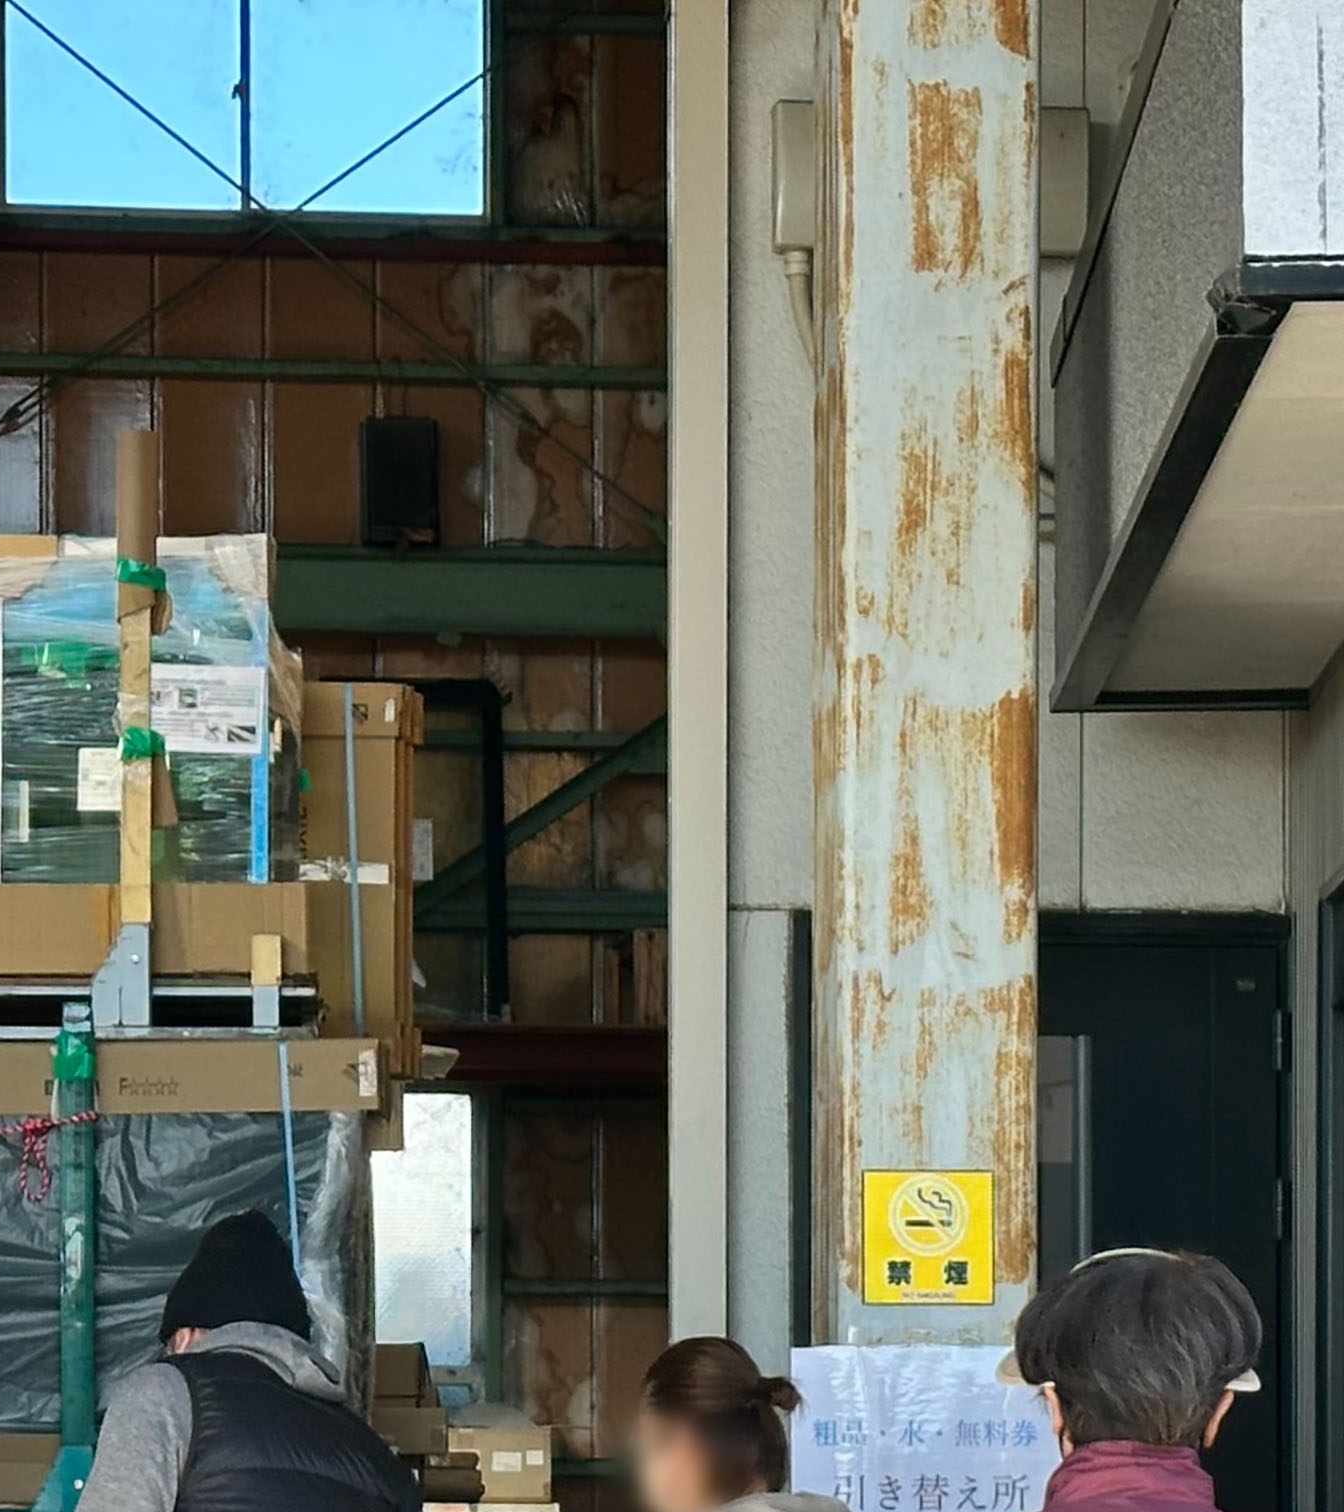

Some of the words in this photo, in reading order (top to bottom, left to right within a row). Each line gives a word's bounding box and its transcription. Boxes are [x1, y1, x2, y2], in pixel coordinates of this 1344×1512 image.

[832, 1474, 1031, 1512] 引き替え所
